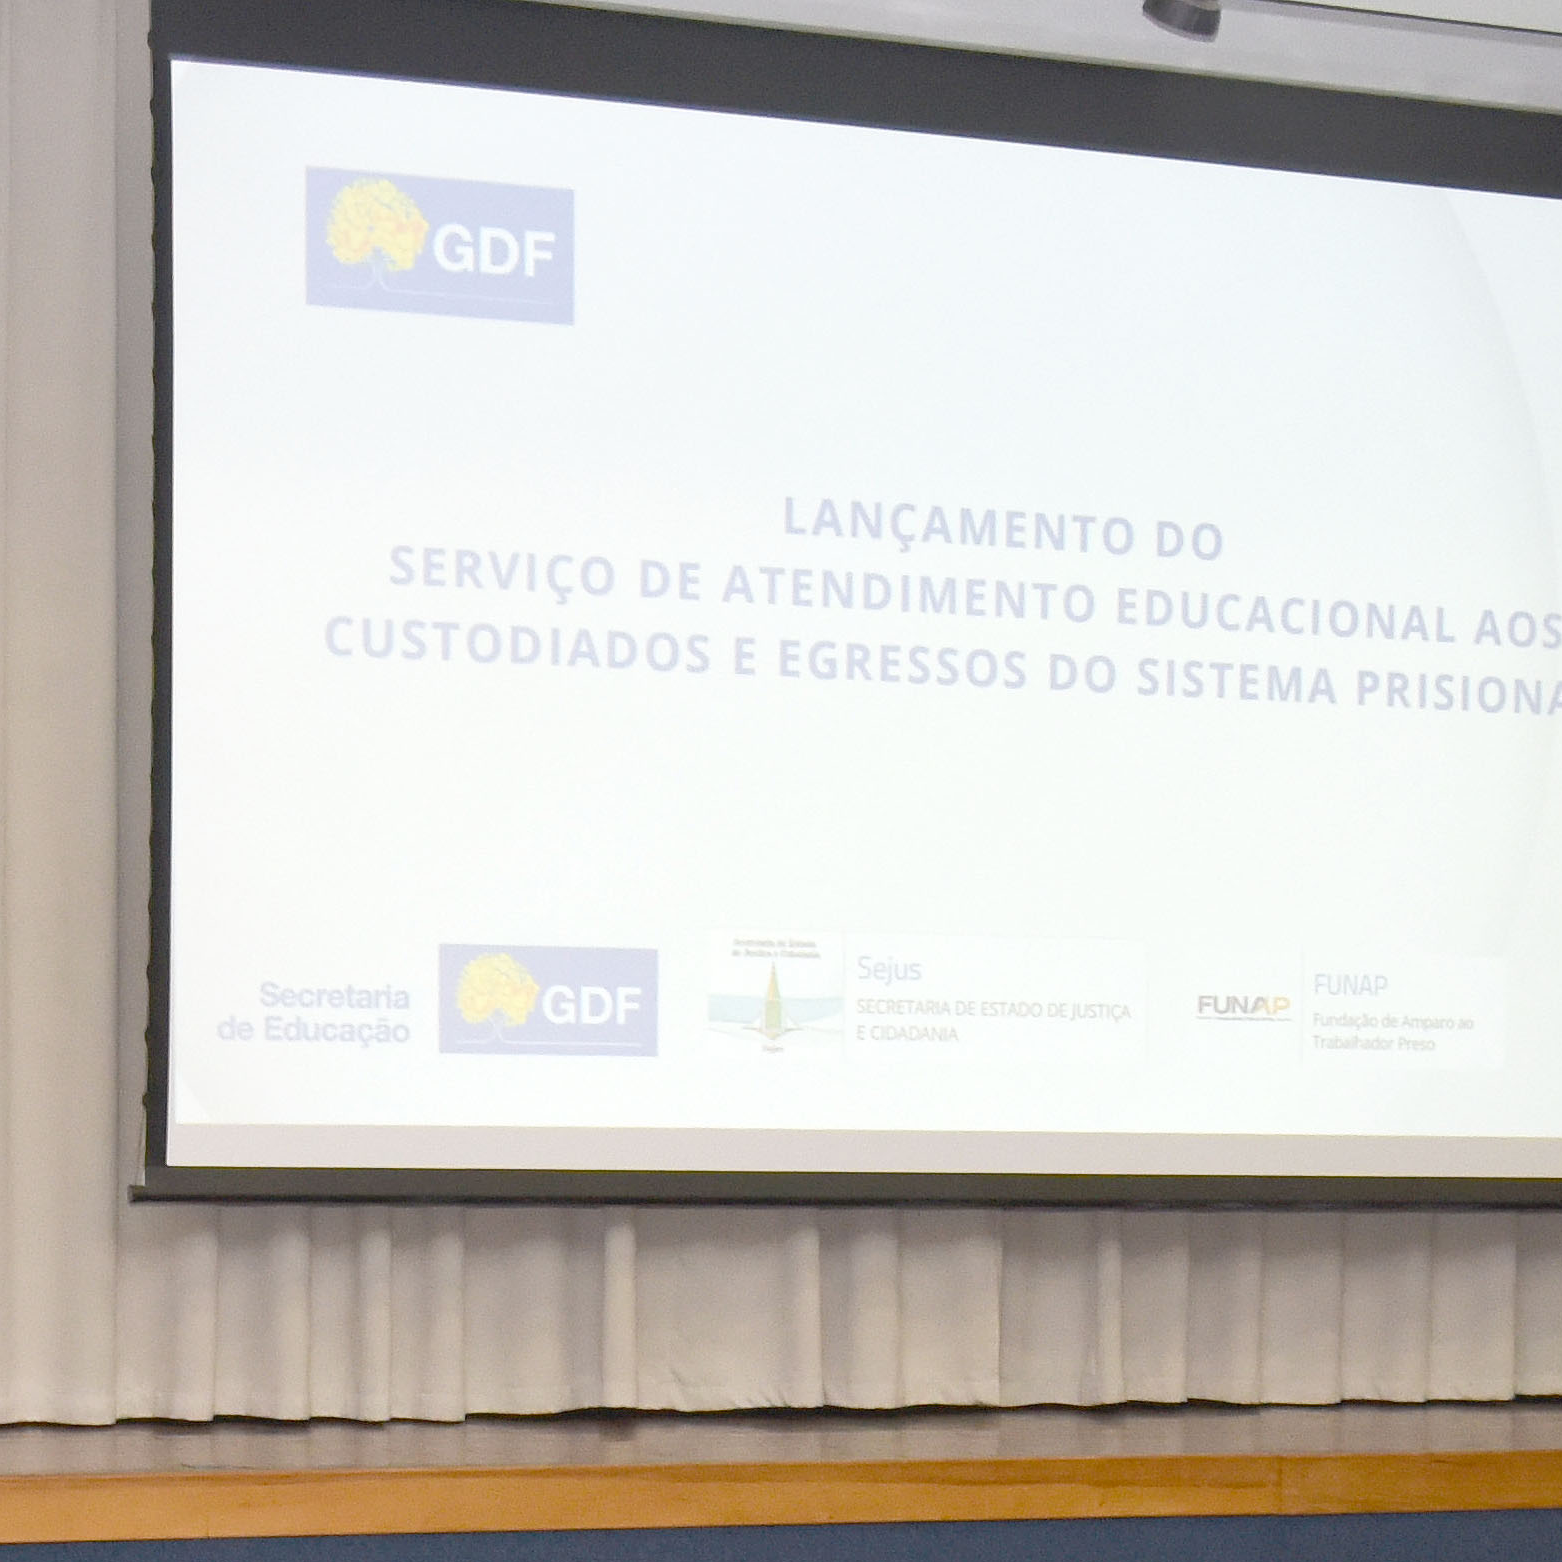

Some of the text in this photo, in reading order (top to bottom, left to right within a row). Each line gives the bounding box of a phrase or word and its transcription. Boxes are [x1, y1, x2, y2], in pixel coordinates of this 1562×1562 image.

[433, 222, 556, 277] GDF
[783, 496, 1223, 562] LANÇAMENTO DO
[389, 545, 616, 606] SERVIÇO
[639, 558, 701, 601] DE
[721, 564, 1096, 624] ATENDIMENTO
[1117, 587, 1456, 643] EDUCACIONAL
[324, 616, 711, 674] CUSTODIADOS
[734, 636, 756, 675] E
[778, 639, 1027, 690] EGRESSOS
[1048, 651, 1117, 694] DO
[1136, 657, 1337, 705] SISTEMA
[857, 956, 922, 986] Sejus
[1314, 973, 1388, 996] FUNAP
[259, 981, 410, 1009] Secretaria
[542, 984, 642, 1025] GDF
[1197, 995, 1291, 1015] FUNAP
[855, 1000, 1131, 1022] SECRETARIA DE ESTADO DE JUSTIÇA
[1313, 1012, 1474, 1031] Fundação de Amparo ao
[216, 1016, 410, 1048] de Educação
[855, 1025, 959, 1042] E CIDADANIA
[1398, 1036, 1436, 1051] Preso
